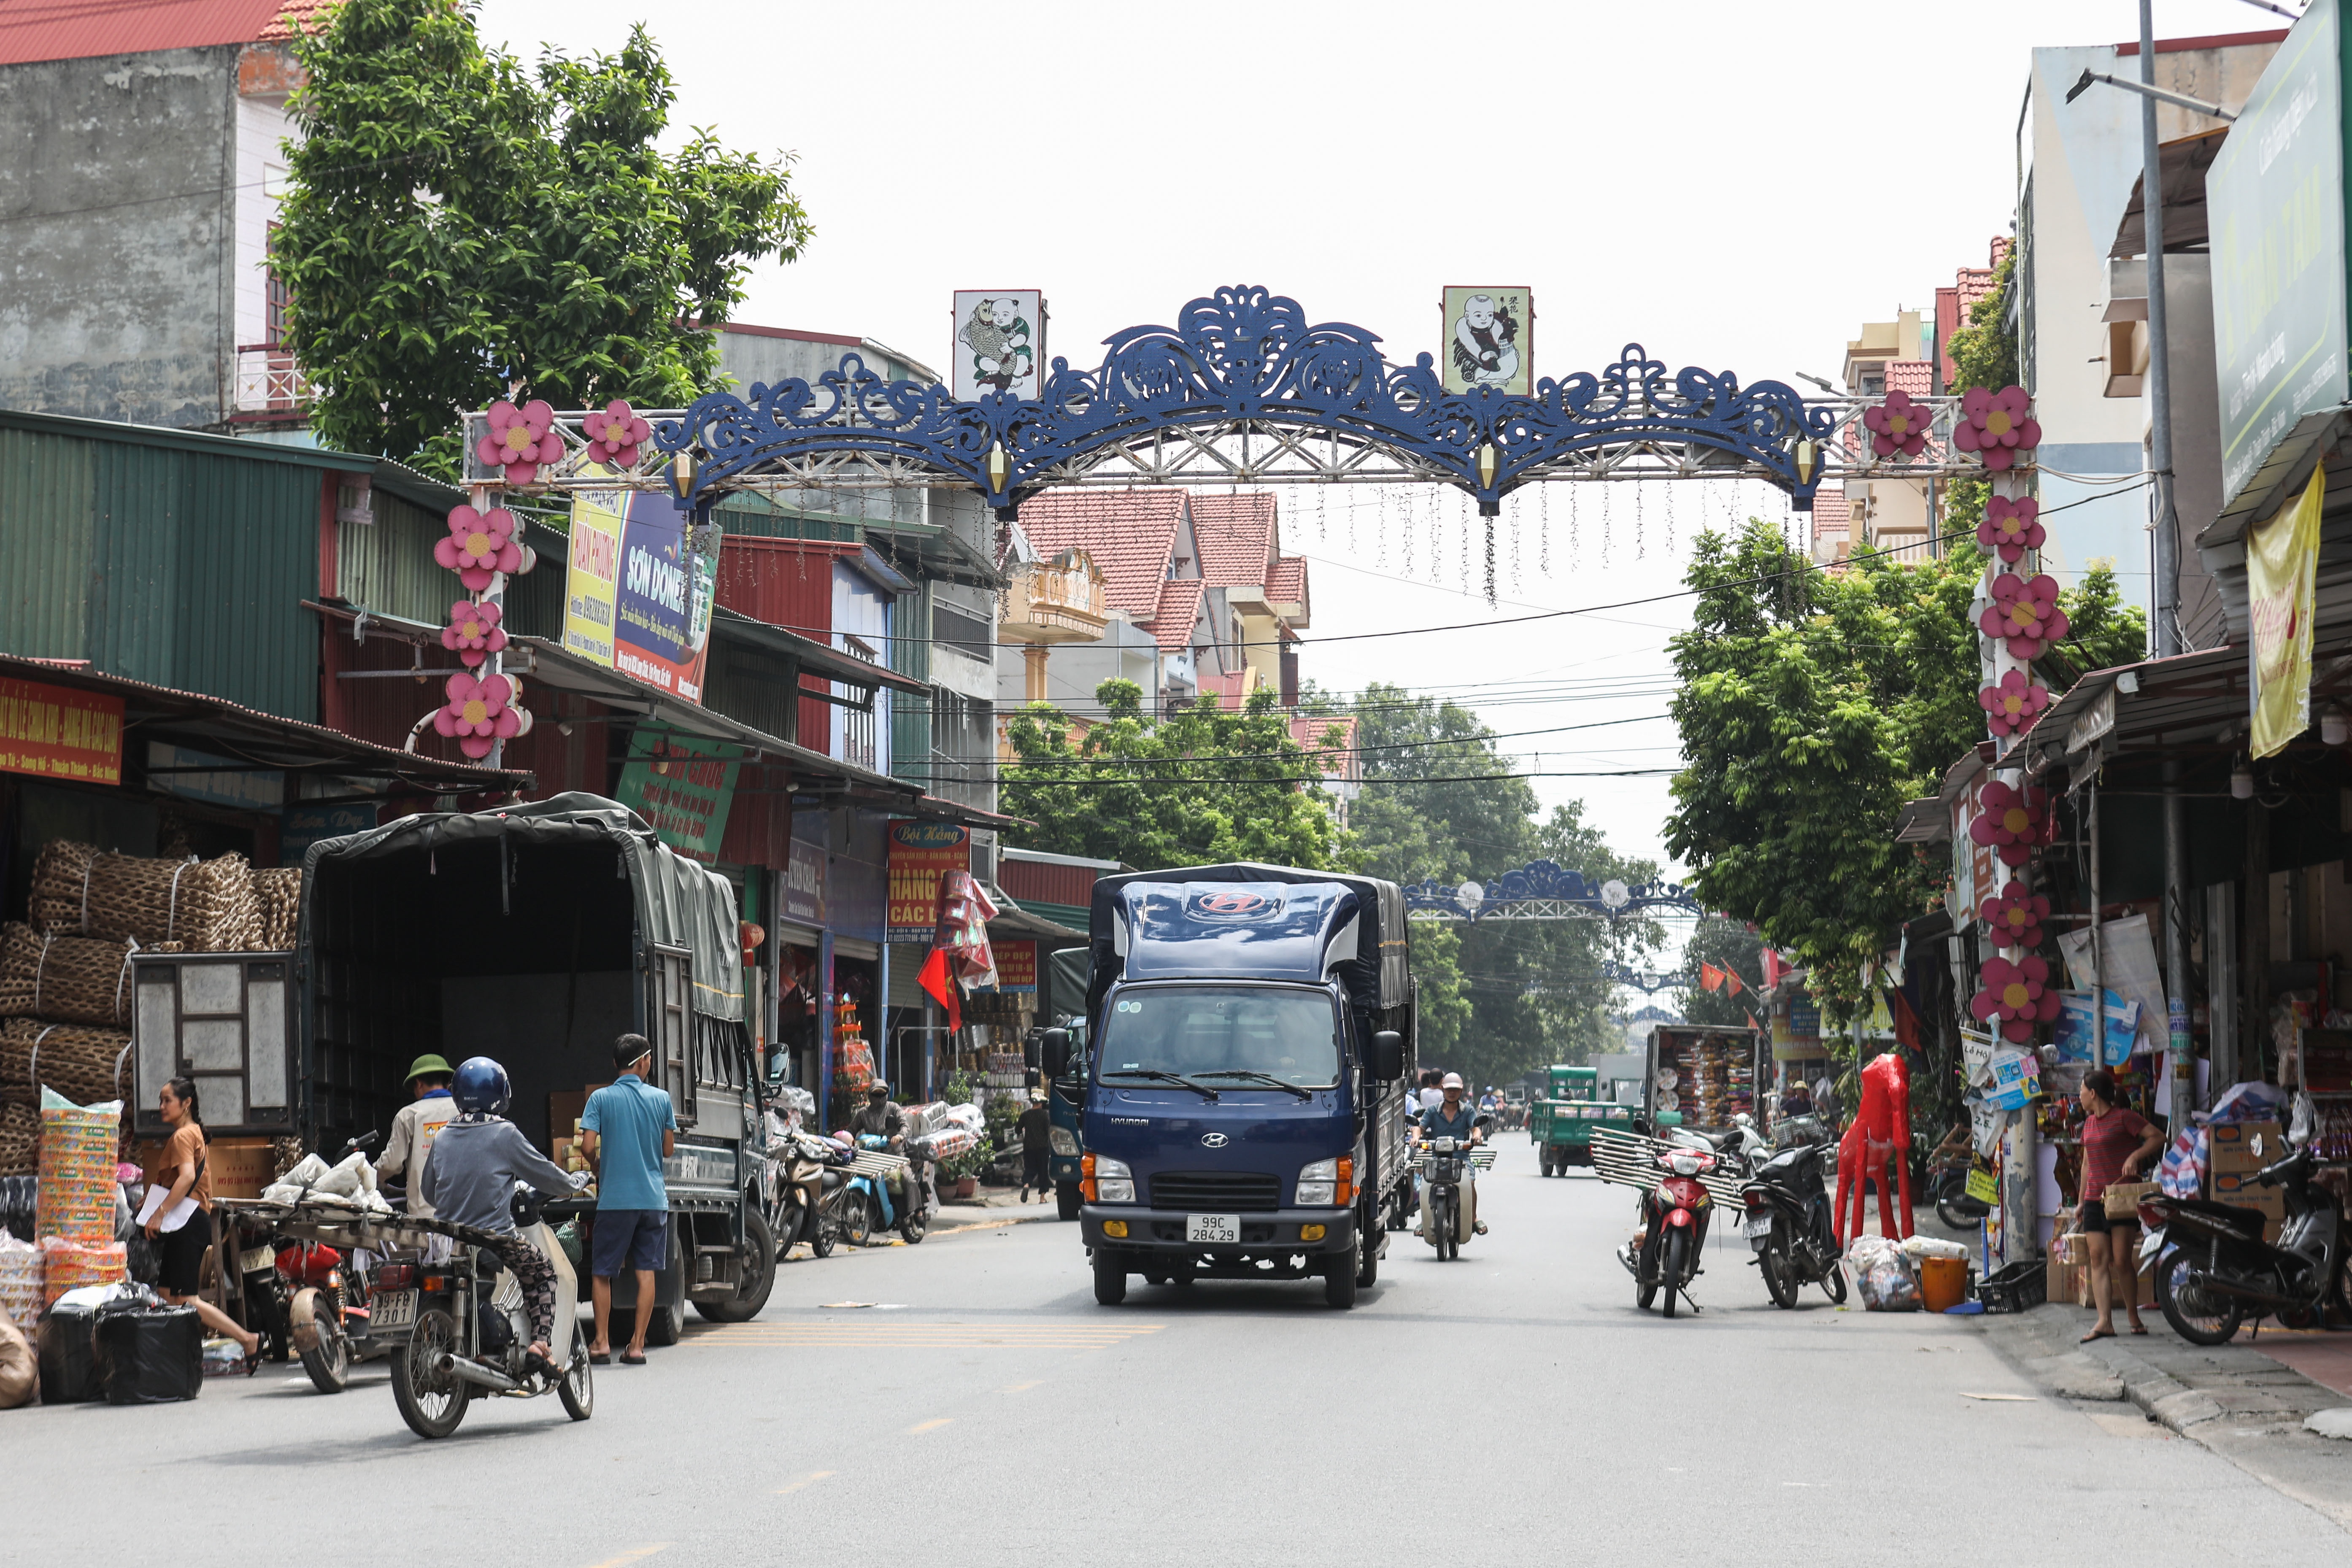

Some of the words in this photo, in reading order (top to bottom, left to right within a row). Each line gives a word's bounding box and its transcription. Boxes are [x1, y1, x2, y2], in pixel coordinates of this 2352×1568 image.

[626, 545, 652, 597] SƠN
[899, 826, 921, 843] Bội
[924, 826, 959, 844] Hằng
[889, 850, 906, 860] CHUYÊN
[907, 850, 915, 859] SẢN
[915, 850, 926, 859] XUẤT
[930, 850, 938, 859] BÁN
[938, 850, 951, 859] BUÔN
[890, 862, 935, 900] HÀNG
[891, 903, 924, 922] CÁC
[1111, 1117, 1149, 1126] HYUNDAI
[1202, 1217, 1224, 1228] 99C
[1193, 1229, 1234, 1241] 284.29
[374, 1308, 407, 1324] 7301
